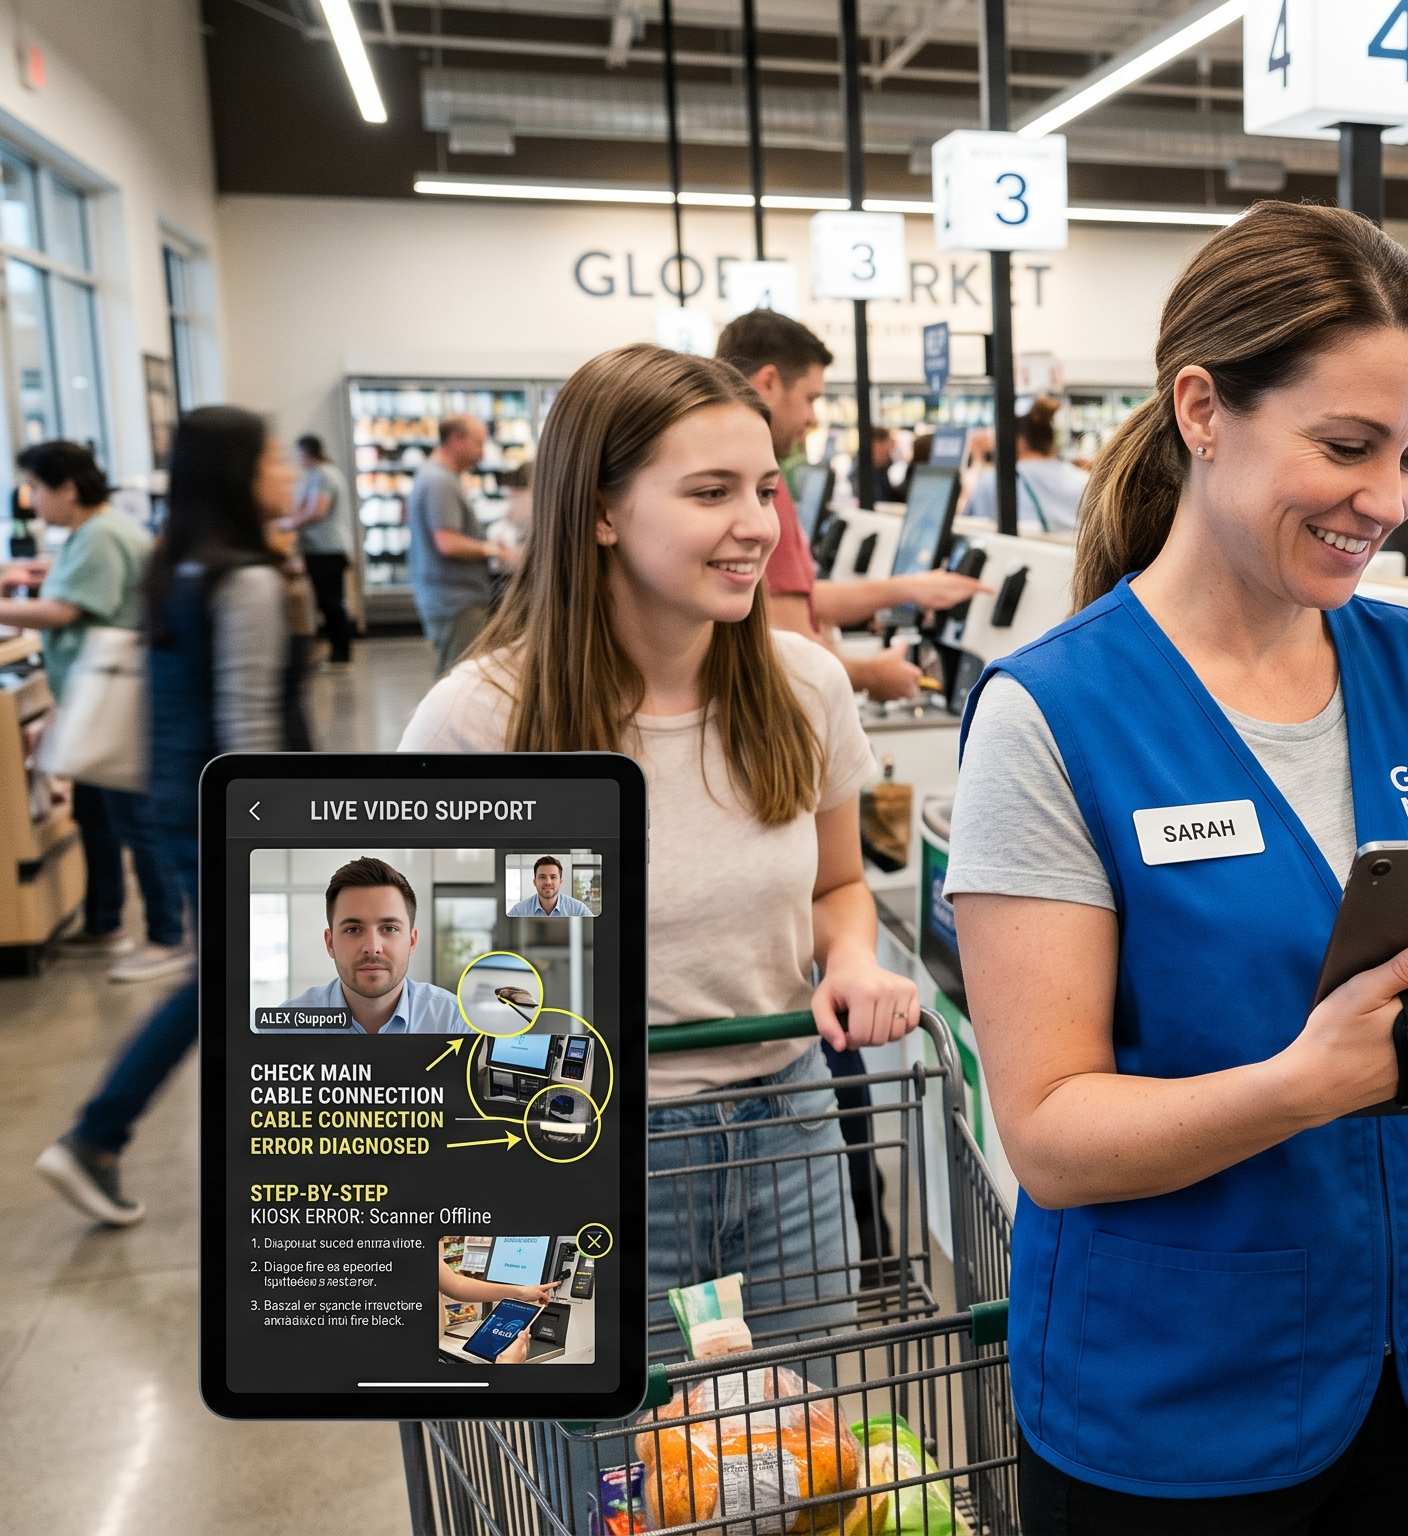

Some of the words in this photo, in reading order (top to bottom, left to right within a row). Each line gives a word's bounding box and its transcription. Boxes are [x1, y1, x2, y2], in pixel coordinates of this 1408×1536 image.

[1269, 0, 1290, 87] 4
[996, 173, 1029, 225] 3
[852, 243, 876, 281] 3
[574, 251, 787, 300] GLO
[311, 800, 358, 821] LIVE
[364, 800, 429, 821] VIDEO
[434, 800, 537, 821] SUPPORT
[1163, 819, 1236, 843] SARAH
[260, 1013, 291, 1024] ALEX
[294, 1012, 347, 1027] (Support)
[250, 1064, 316, 1082] CHECK
[321, 1064, 372, 1082] MAIN
[250, 1087, 313, 1104] CABLE
[318, 1087, 444, 1104] CONNECTION
[250, 1111, 313, 1128] CABLE
[318, 1111, 444, 1128] CONNECTION
[250, 1137, 314, 1155] ERROR
[320, 1137, 430, 1155] DIAGNOSED
[250, 1184, 389, 1202] STEP-BY-STEP
[251, 1208, 301, 1224] KIOSK
[306, 1208, 364, 1224] ERROR:
[369, 1208, 435, 1224] Scanner
[440, 1207, 492, 1224] Offline
[251, 1238, 261, 1249] 1.
[250, 1261, 261, 1272] 2.
[250, 1300, 261, 1311] 3.
